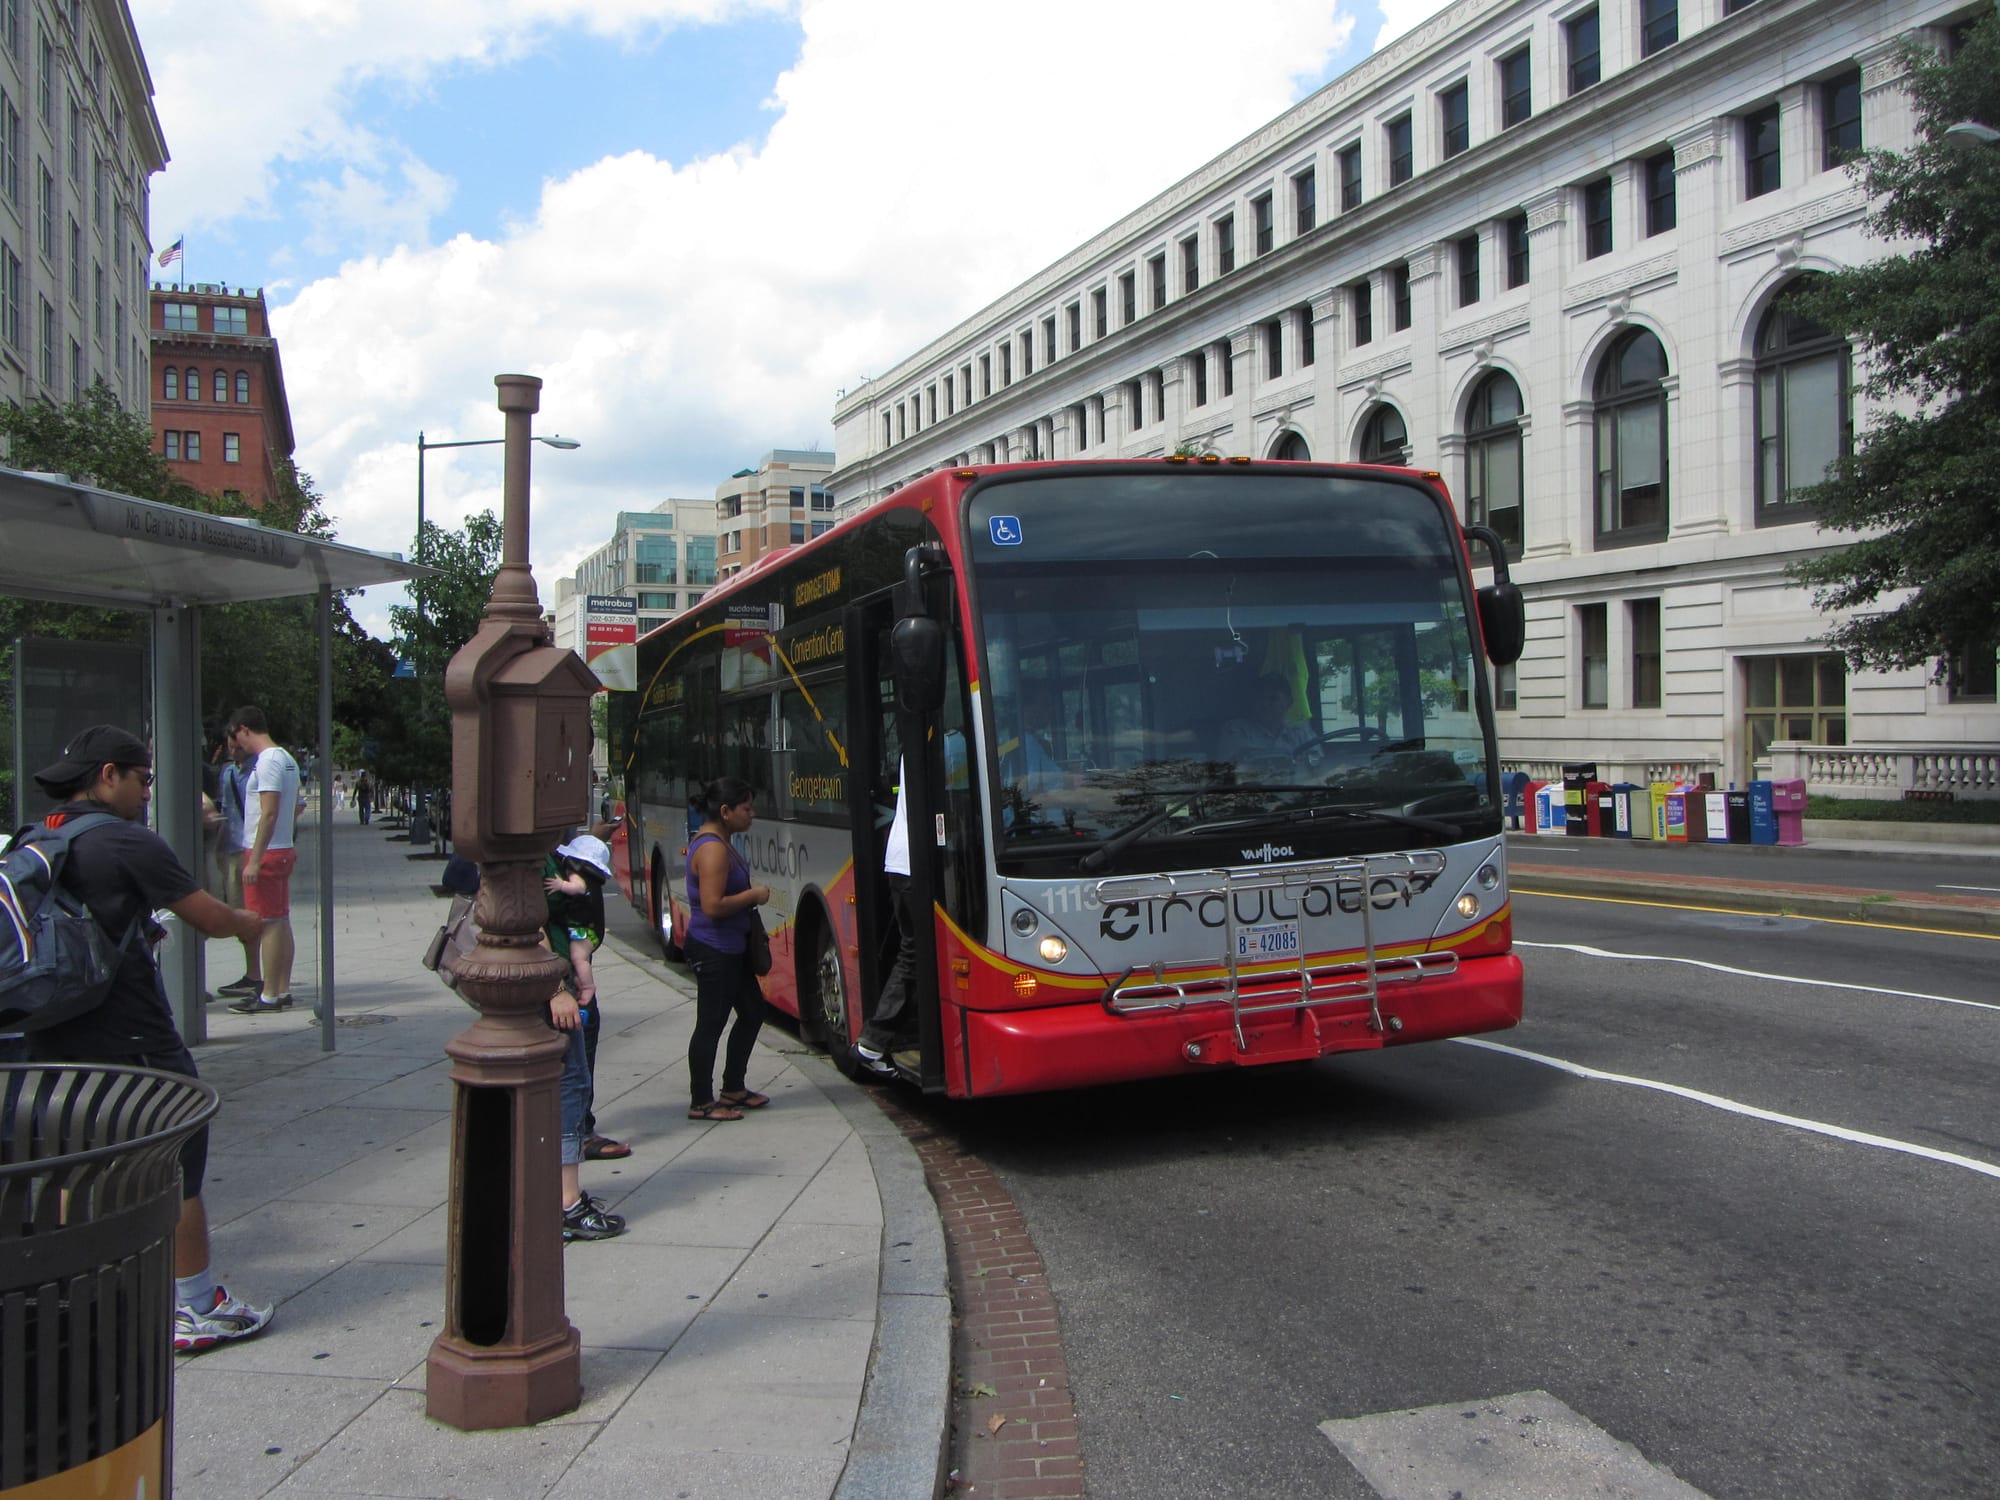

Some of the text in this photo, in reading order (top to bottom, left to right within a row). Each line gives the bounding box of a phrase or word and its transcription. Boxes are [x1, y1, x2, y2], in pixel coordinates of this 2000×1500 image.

[590, 599, 634, 608] metrobus
[790, 630, 826, 665] Convention
[788, 771, 842, 807] Georgetown
[1041, 882, 1100, 914] 1113
[1240, 931, 1297, 954] B 42085
